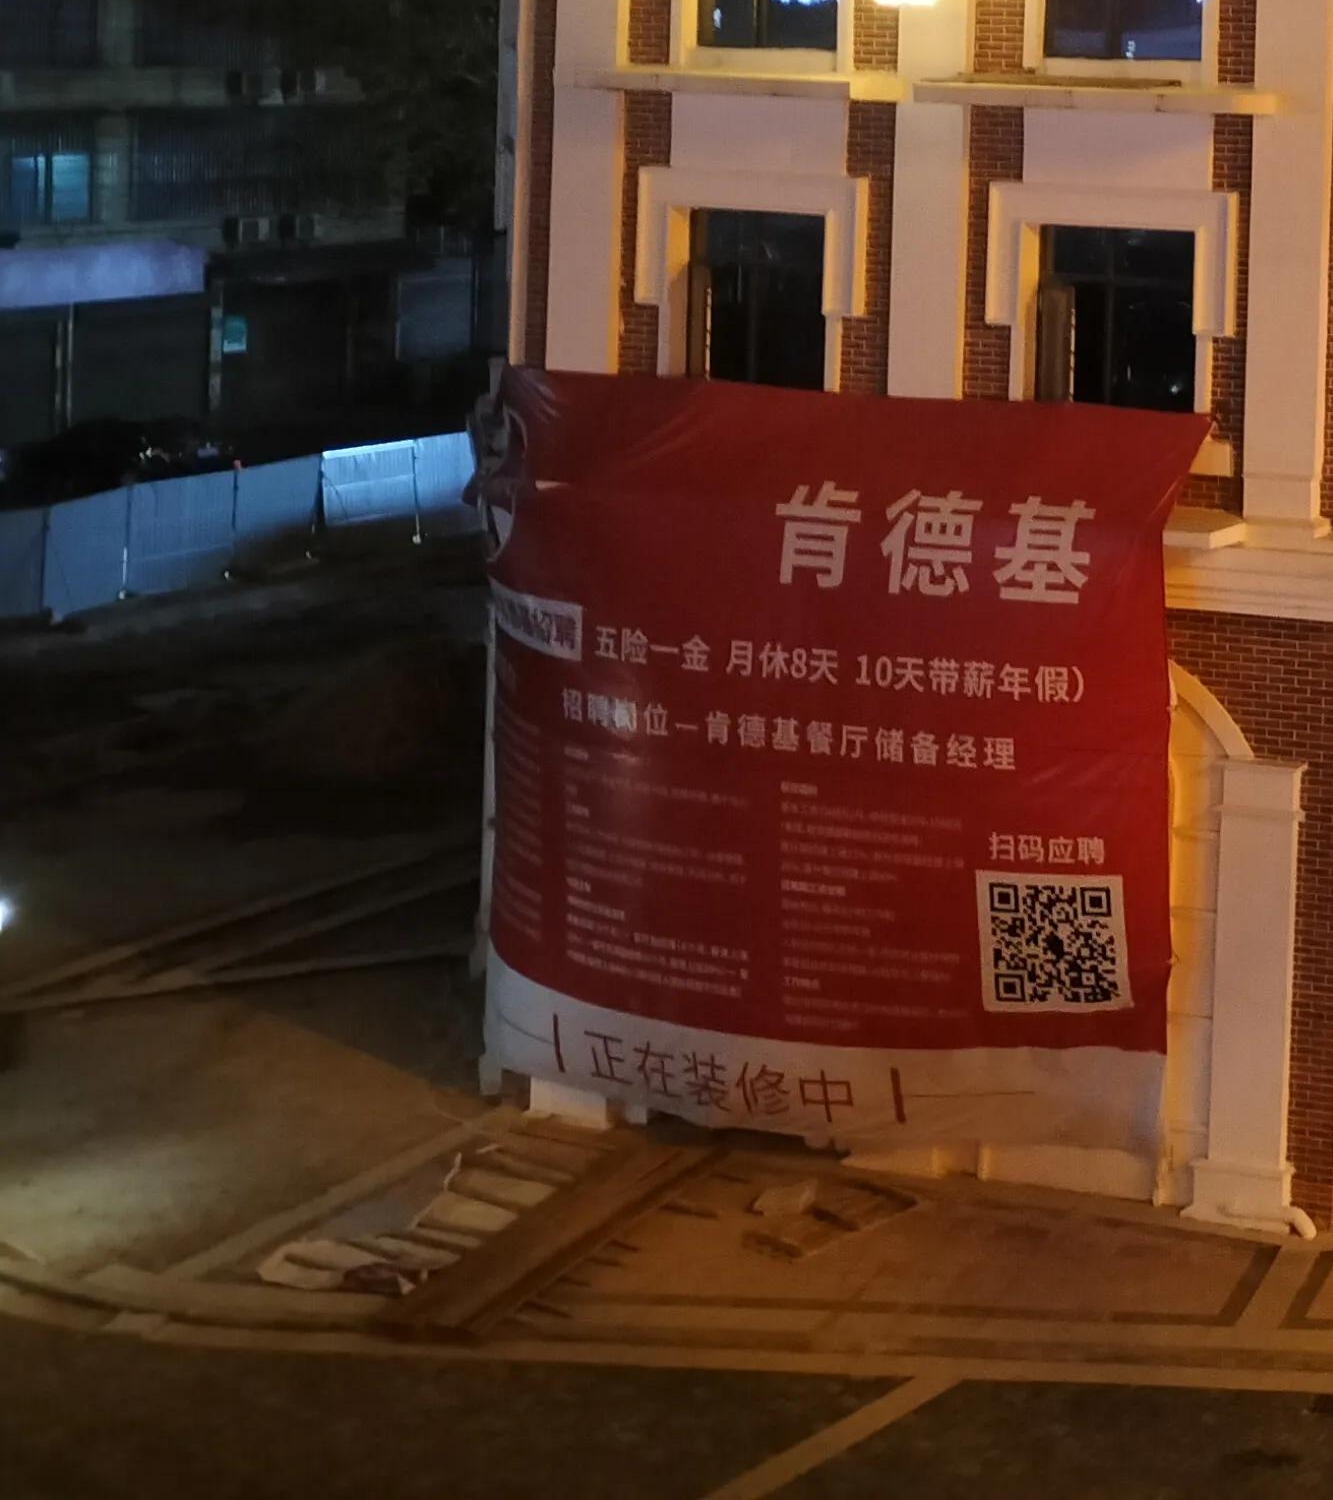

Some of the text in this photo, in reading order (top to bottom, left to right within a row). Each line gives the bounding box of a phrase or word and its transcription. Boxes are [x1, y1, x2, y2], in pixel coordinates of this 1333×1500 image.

[774, 482, 1096, 604] 肯德基
[595, 624, 711, 672] 五险一金
[726, 640, 838, 685] 月休8天
[989, 831, 1106, 865] 扫码应聘
